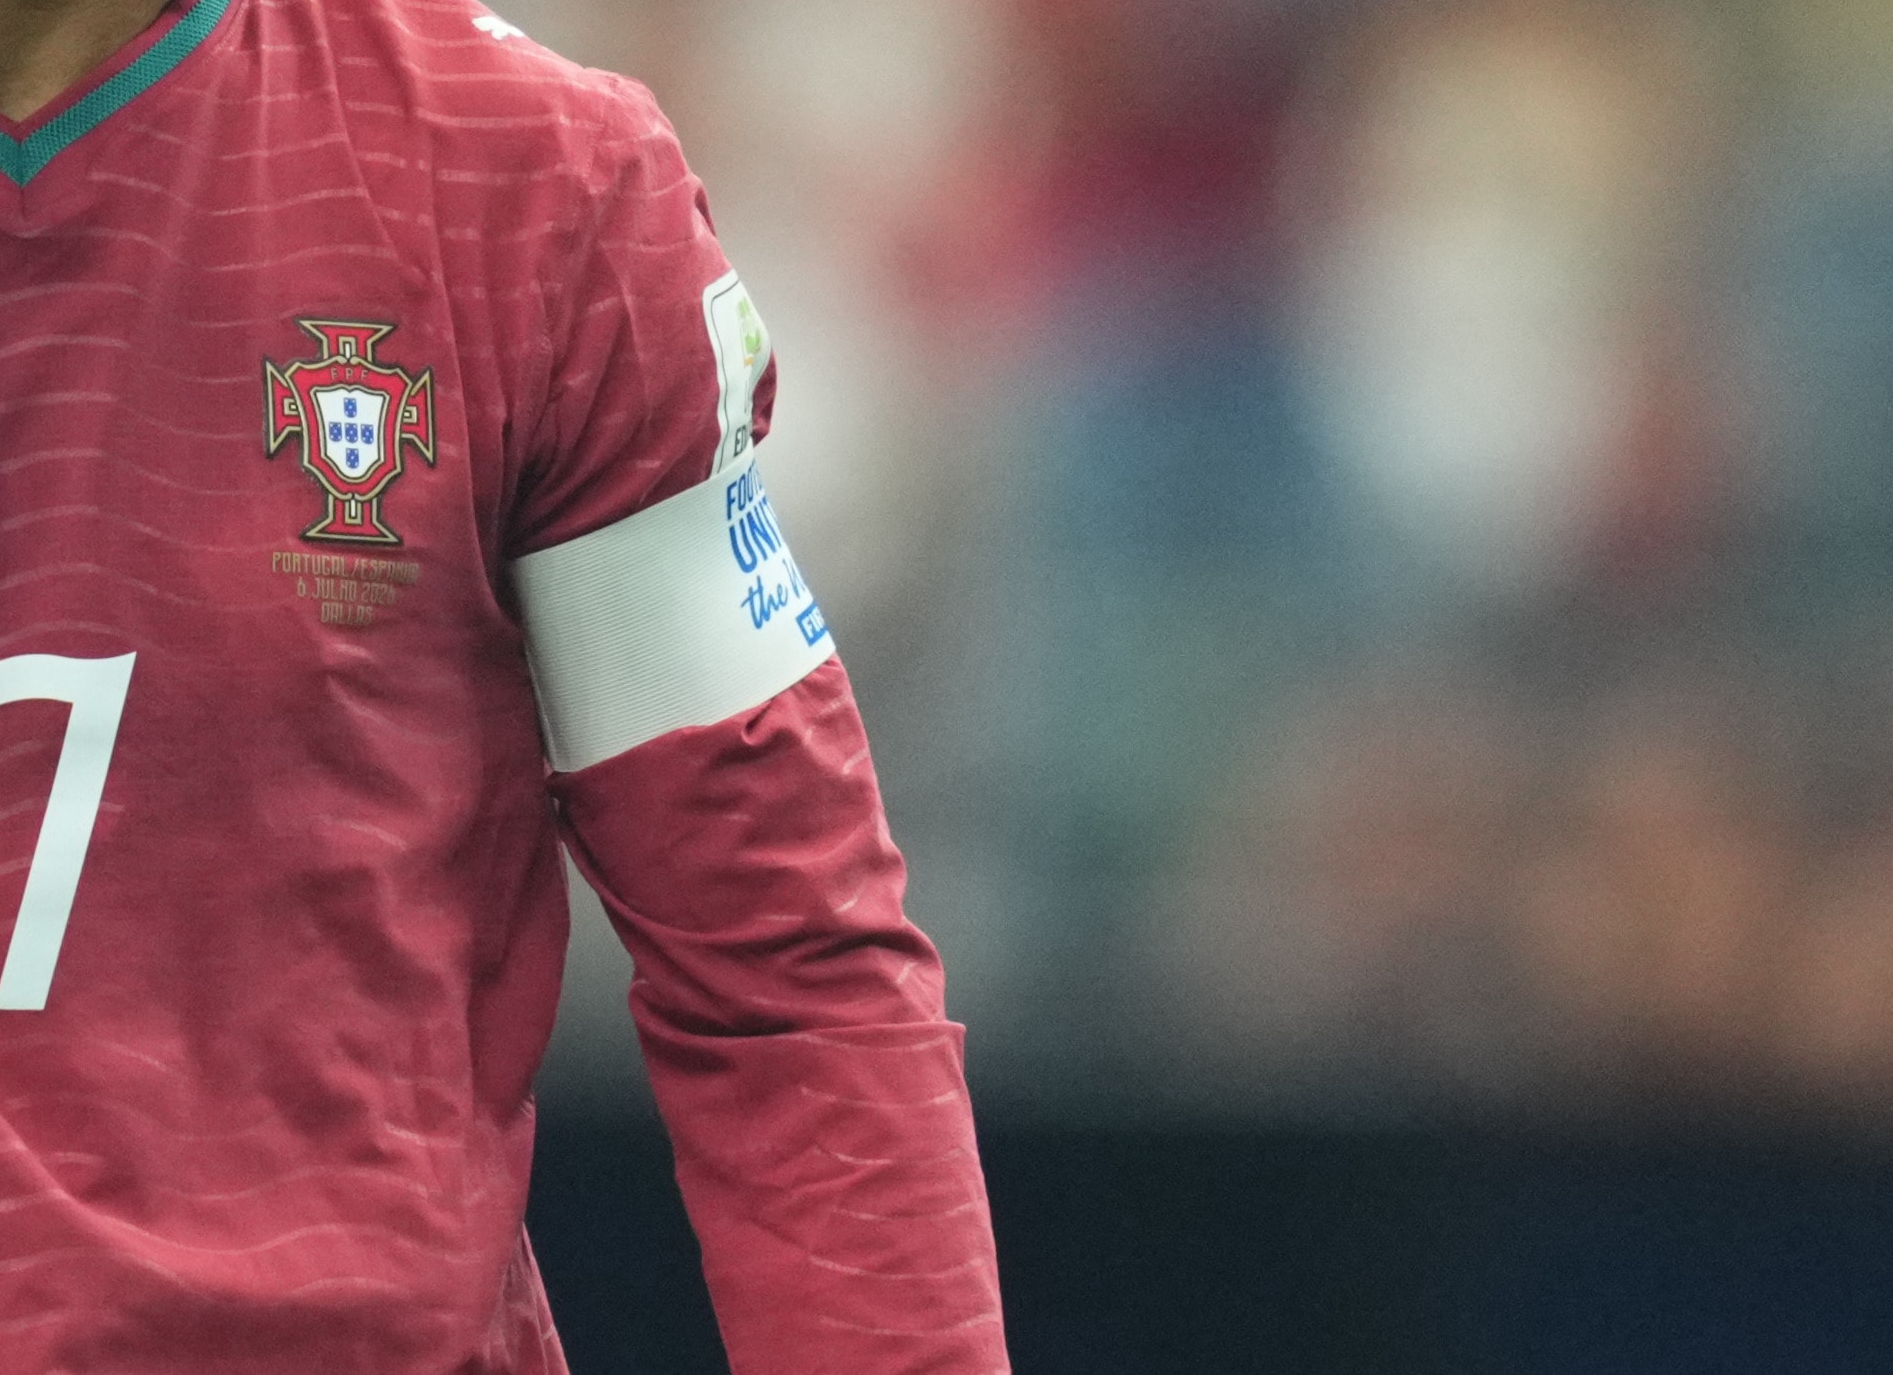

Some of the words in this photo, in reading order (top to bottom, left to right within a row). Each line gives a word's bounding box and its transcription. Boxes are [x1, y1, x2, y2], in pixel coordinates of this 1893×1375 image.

[330, 366, 368, 381] FPF
[312, 578, 357, 603] JULHO
[741, 574, 789, 630] the
[320, 601, 374, 626] DALLAS
